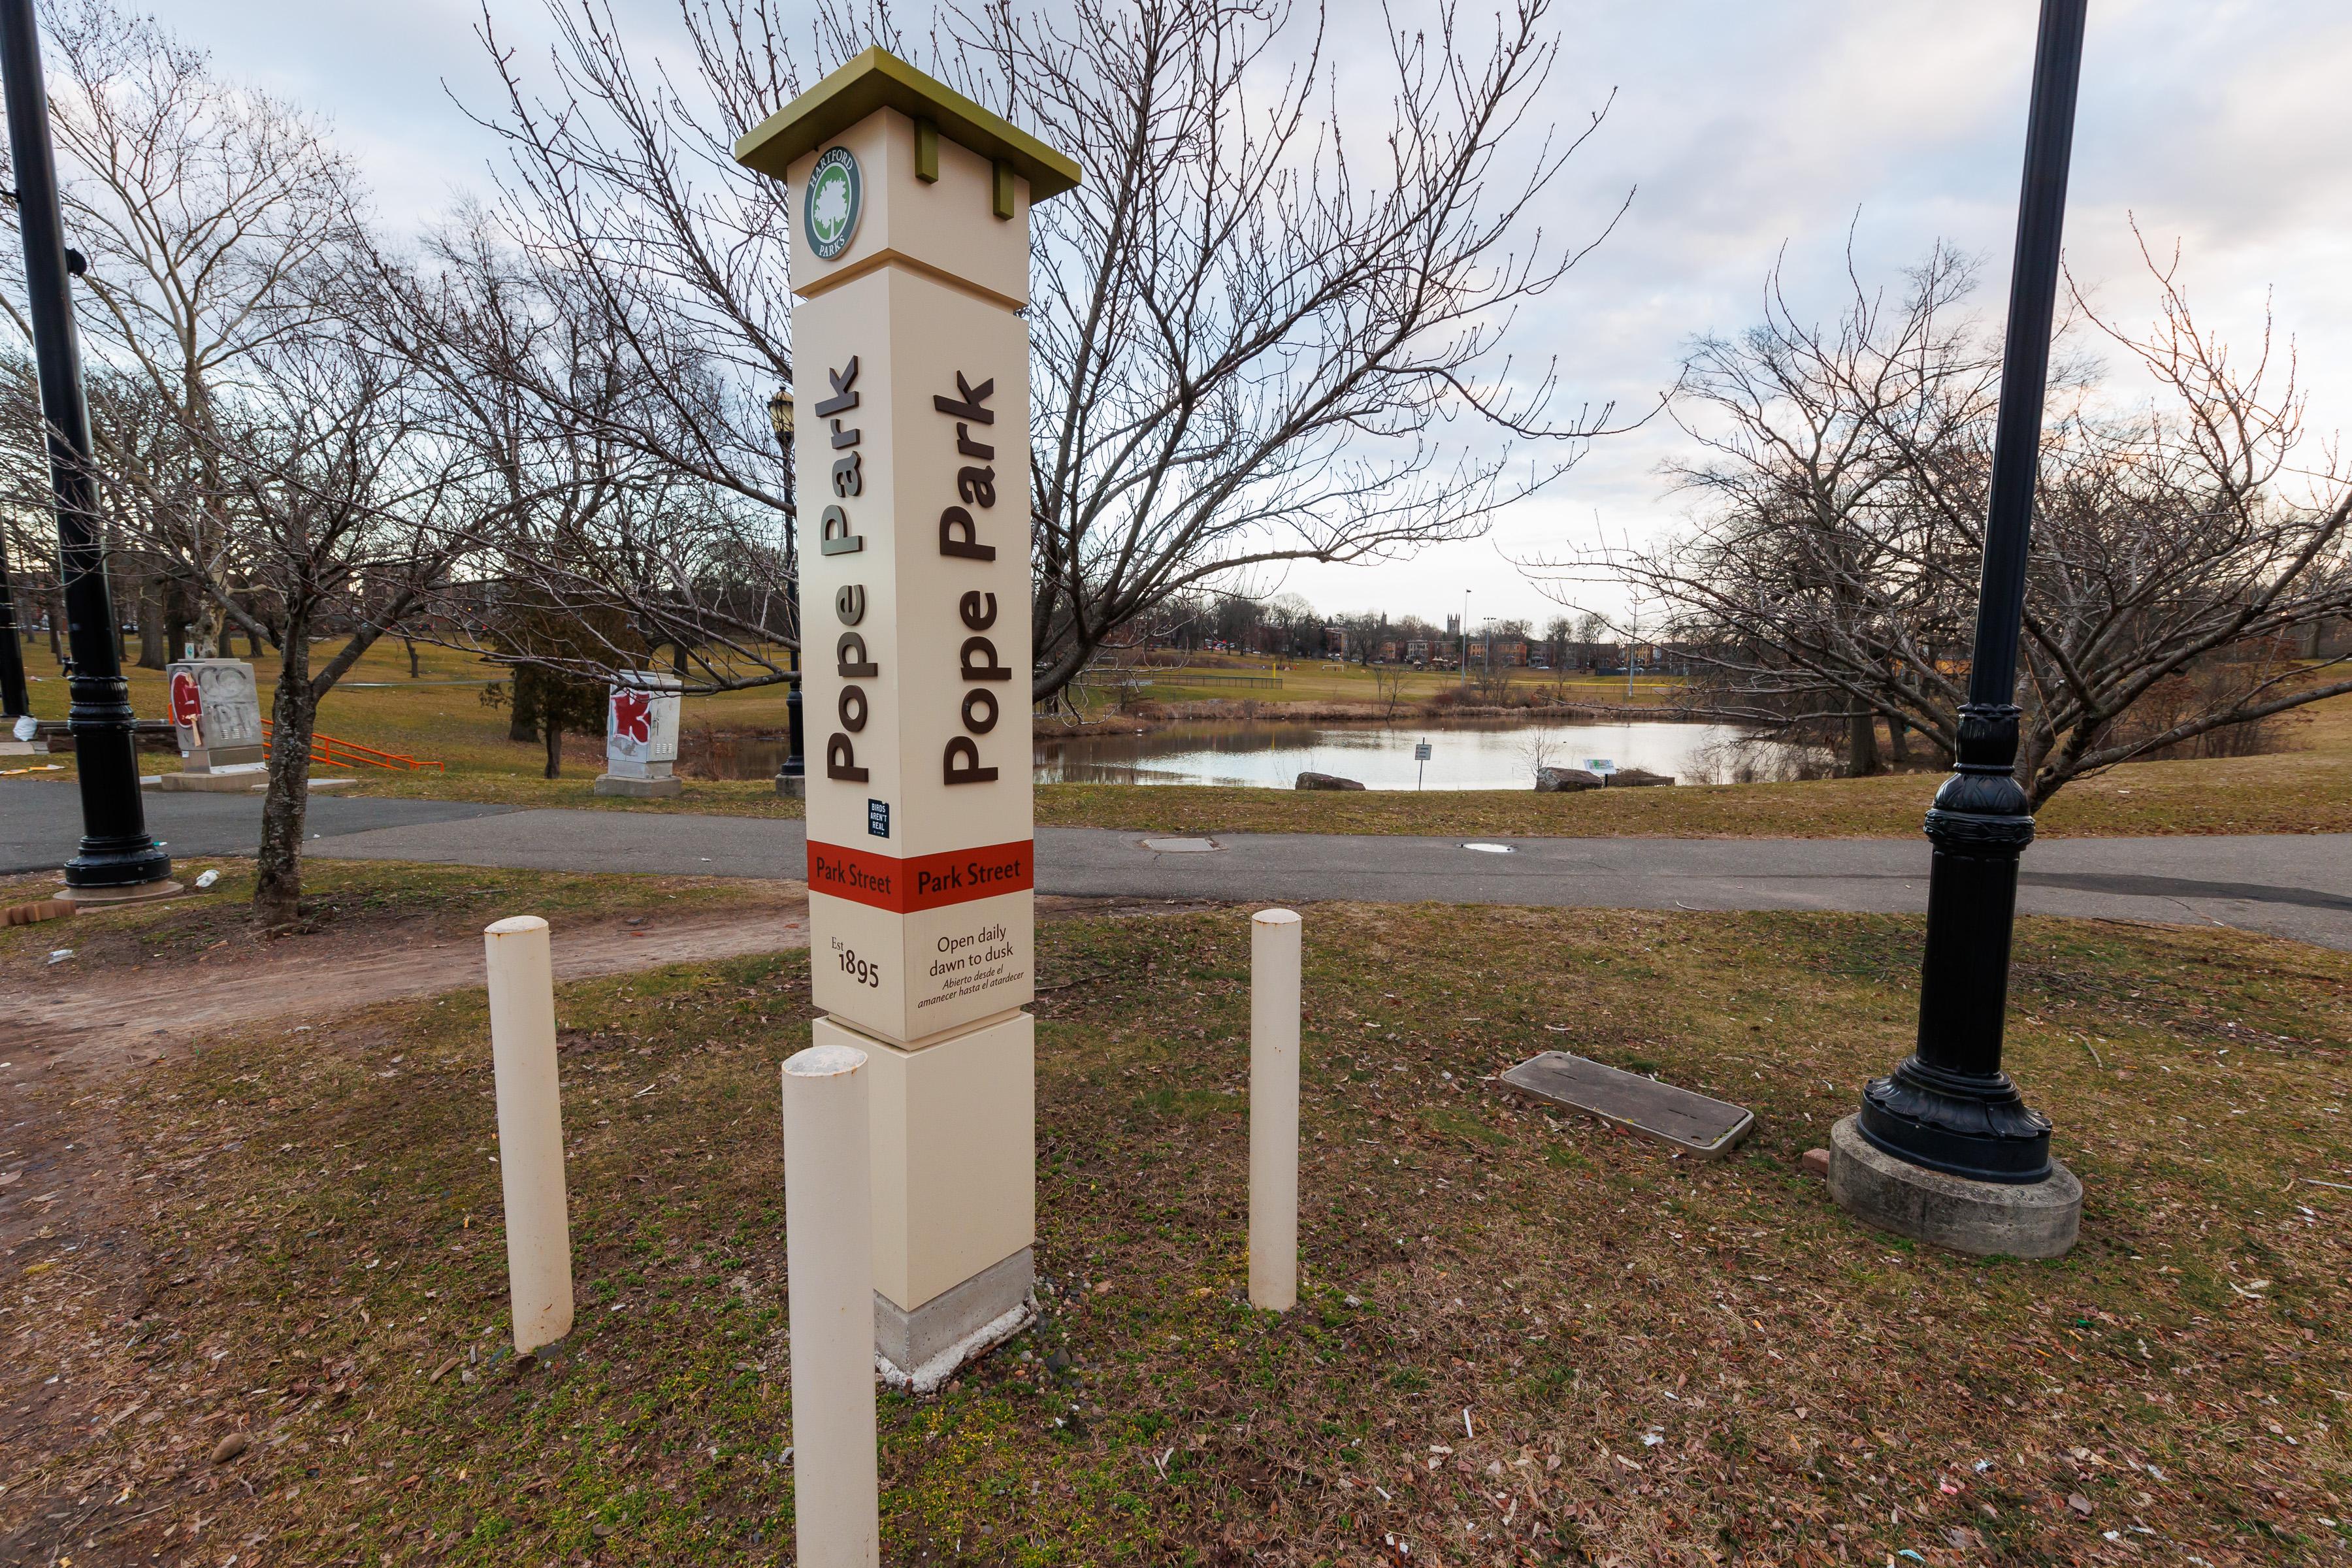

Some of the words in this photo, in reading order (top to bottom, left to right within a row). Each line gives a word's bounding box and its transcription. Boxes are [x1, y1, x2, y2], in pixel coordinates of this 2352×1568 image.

[809, 149, 853, 189] HARTFORD
[819, 235, 846, 257] PARKS
[814, 355, 863, 557] Park
[933, 370, 996, 561] Park
[826, 584, 879, 783] Pope
[943, 590, 1012, 785] Pope
[870, 812, 887, 823] AREN'T
[872, 803, 886, 813] BIRDS
[872, 821, 885, 831] REAL
[817, 857, 846, 884] Park
[849, 864, 891, 894] Street
[918, 865, 962, 894] Park
[968, 859, 1021, 885] Street
[832, 936, 843, 951] Est
[938, 935, 974, 954] Open
[978, 923, 1006, 943] daily
[839, 949, 879, 988] 1895
[930, 958, 965, 977] dawn
[968, 954, 981, 966] to
[985, 941, 1013, 962] dusk
[942, 975, 972, 990] Abierto
[973, 967, 995, 981] desde
[997, 964, 1004, 974] el
[917, 990, 957, 1008] amanecer
[959, 984, 980, 996] hasta
[982, 979, 988, 990] el
[990, 972, 1024, 987] atardecer
